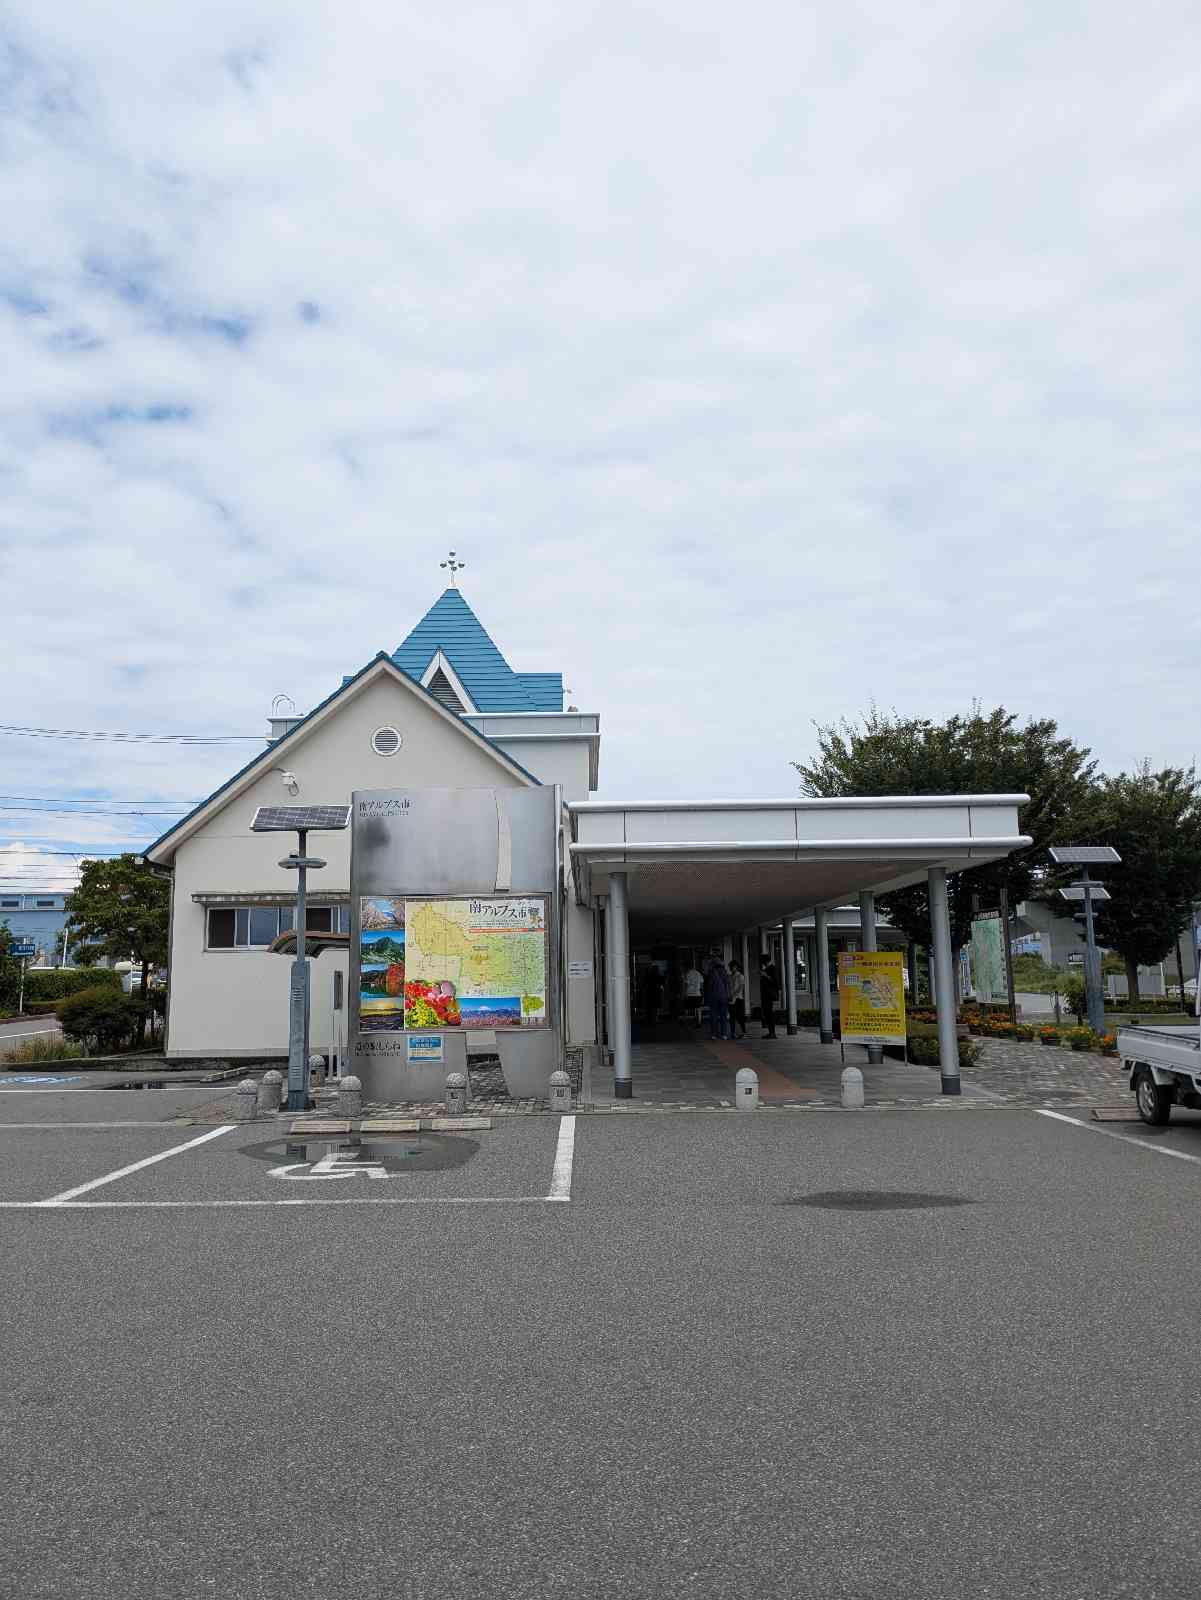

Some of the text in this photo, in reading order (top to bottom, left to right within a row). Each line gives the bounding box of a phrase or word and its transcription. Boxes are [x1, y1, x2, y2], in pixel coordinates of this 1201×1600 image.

[469, 900, 527, 918] 南アルプス市
